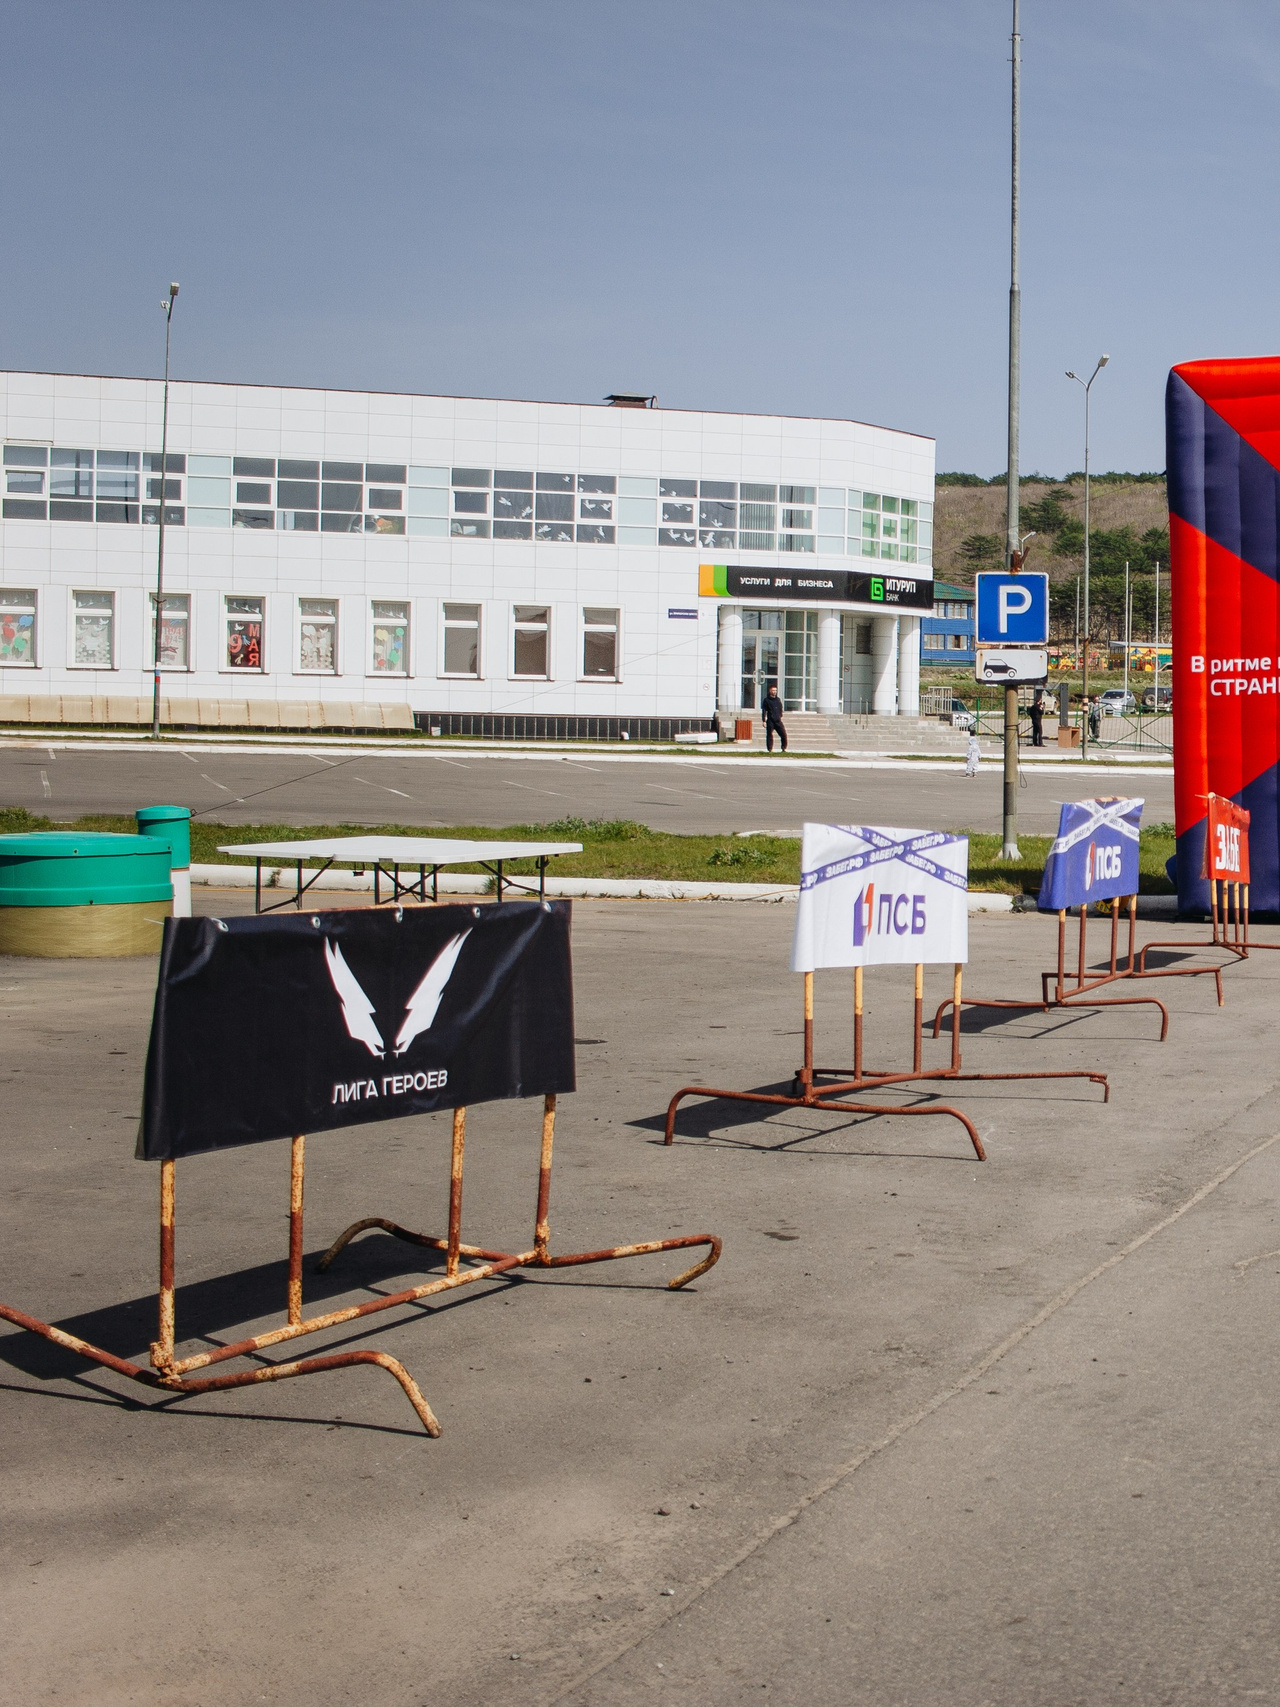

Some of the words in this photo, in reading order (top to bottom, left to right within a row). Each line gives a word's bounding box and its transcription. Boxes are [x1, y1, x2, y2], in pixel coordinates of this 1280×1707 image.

[740, 577, 771, 586] УСЛУГИ
[774, 577, 792, 587] ДЛЯ
[798, 579, 834, 588] БИЗНЕСА
[886, 578, 917, 593] ИТУРУП
[886, 592, 900, 602] БАНК
[998, 585, 1033, 634] P
[228, 634, 243, 653] 9
[1191, 655, 1205, 673] В
[1210, 656, 1272, 675] ритме
[1095, 845, 1122, 881] ПСБ
[877, 893, 927, 936] ПСБ
[331, 1080, 379, 1105] ЛИГА
[383, 1070, 448, 1096] ГЕРОЕВ
